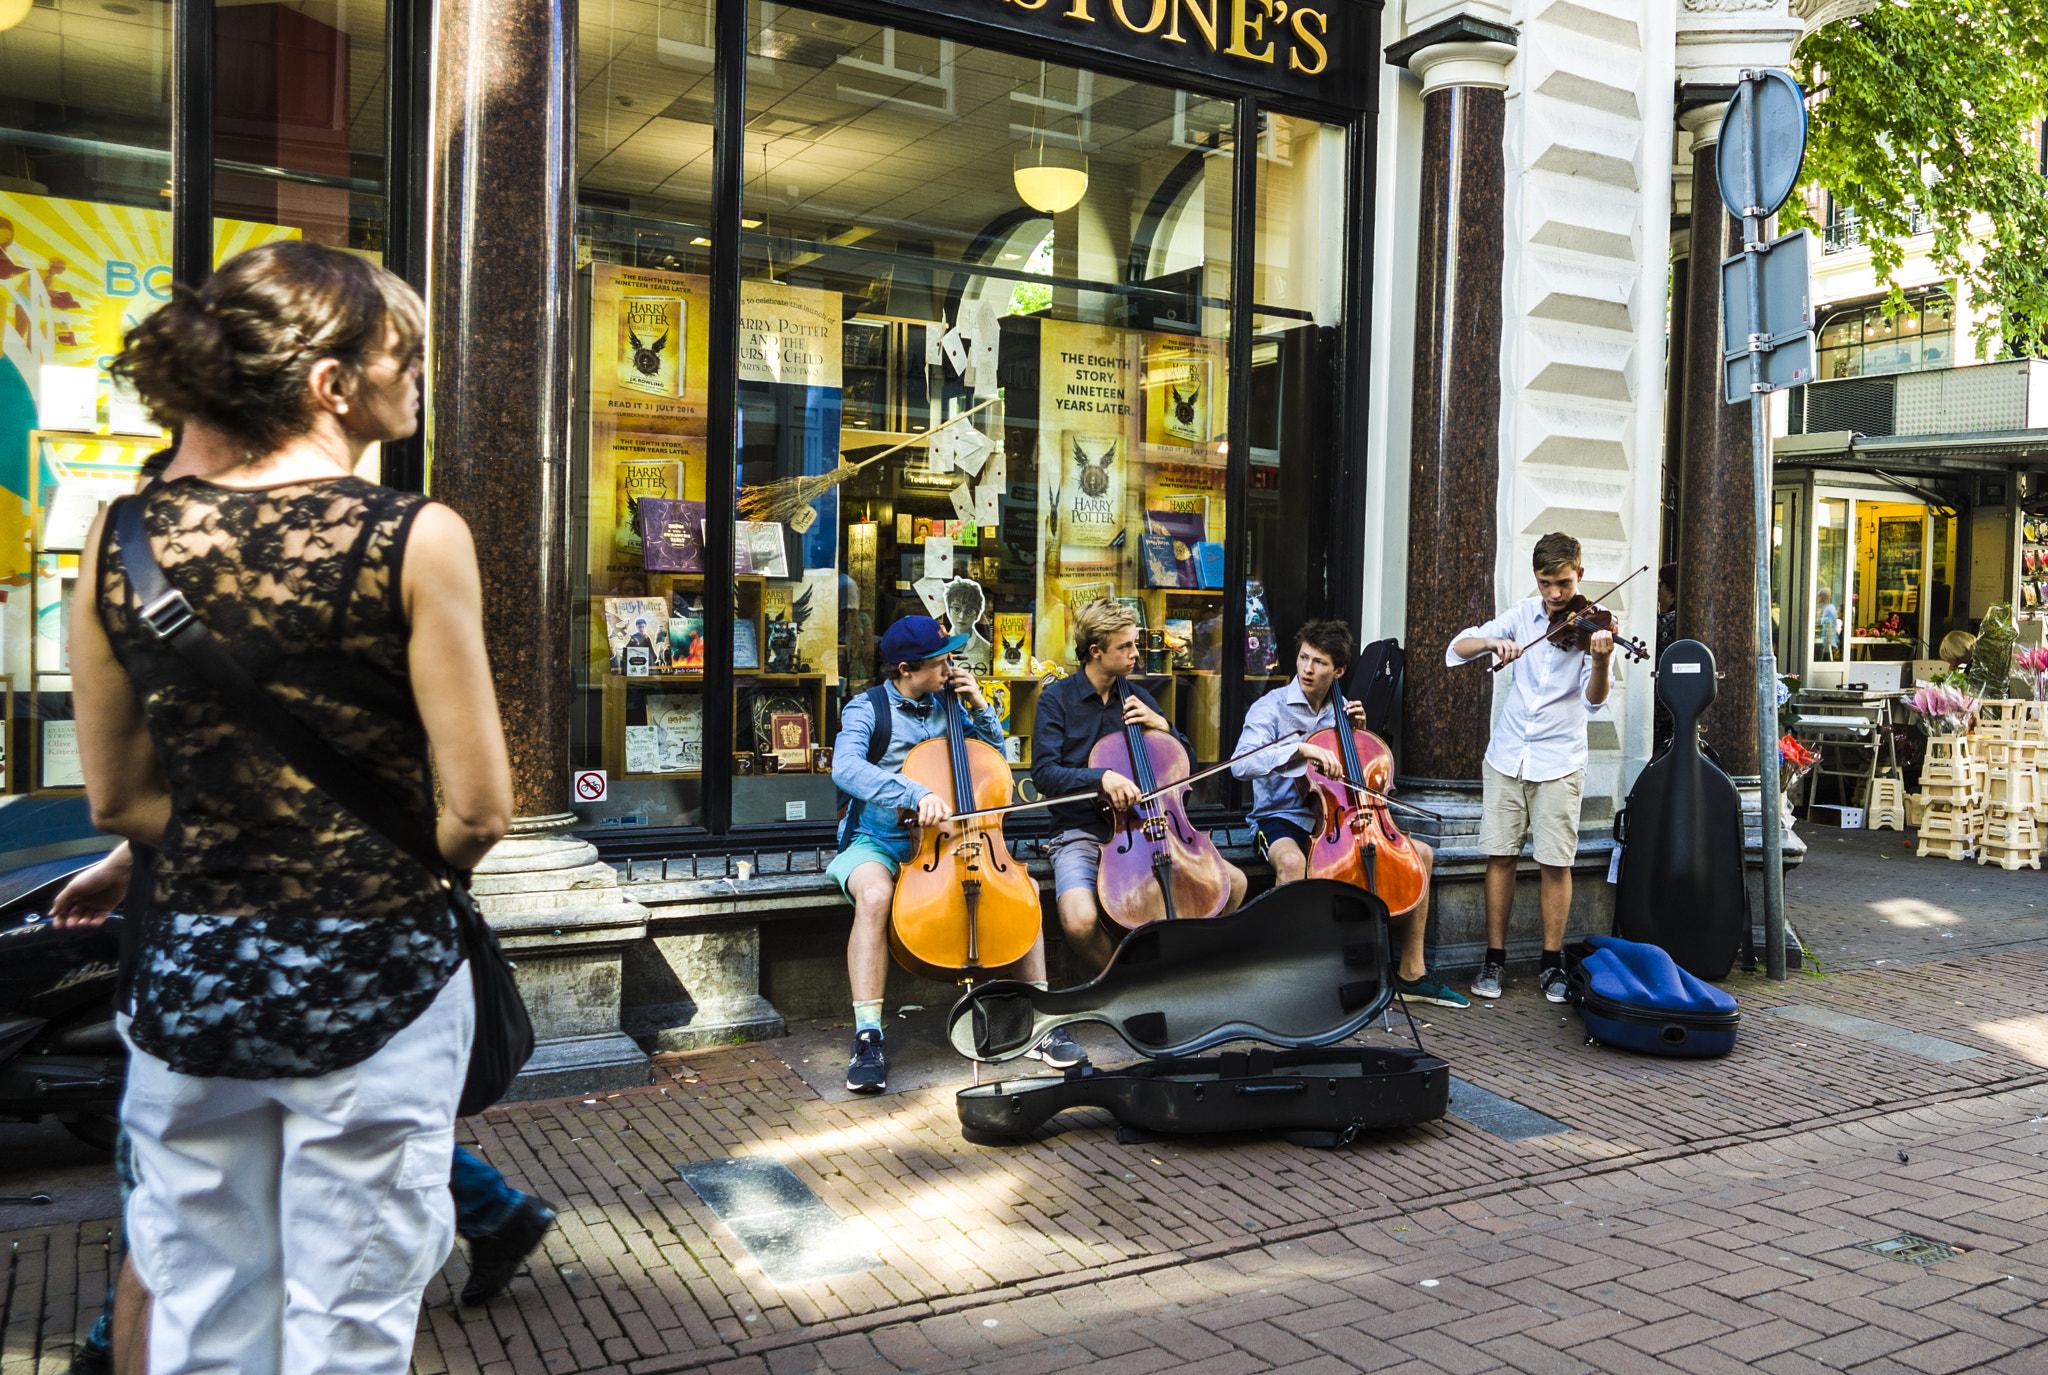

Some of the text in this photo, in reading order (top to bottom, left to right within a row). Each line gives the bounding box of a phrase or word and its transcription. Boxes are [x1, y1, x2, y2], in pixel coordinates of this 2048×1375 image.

[1003, 0, 1328, 74] ONE'S
[106, 260, 173, 301] BO
[615, 280, 648, 288] NINETEEN
[672, 286, 693, 294] LATER.
[664, 278, 686, 286] STORY.
[630, 302, 668, 314] HARRY
[756, 298, 789, 306] celebrate
[790, 301, 802, 309] the
[803, 305, 826, 320] launch
[627, 312, 670, 326] POTTER
[740, 318, 828, 338] ARRY POTTER
[750, 334, 806, 350] AND THE
[740, 348, 824, 364] URSED CHILD
[1060, 352, 1130, 370] THE EIGHTH
[739, 361, 760, 372] PARTS
[800, 368, 818, 376] TWO
[1076, 370, 1116, 384] STORY.
[1067, 384, 1124, 400] NINETEEN
[608, 400, 631, 408] READ
[656, 404, 675, 412] JULY
[677, 406, 694, 414] 2016
[1056, 398, 1134, 416] YEARS LATER.
[628, 466, 666, 478] HARRY
[625, 476, 667, 488] POTTER
[928, 476, 952, 485] Fiction
[1074, 497, 1114, 512] HARRY
[1170, 500, 1196, 510] HARRY
[1072, 510, 1116, 524] POTTER
[766, 590, 786, 598] ARRY
[1072, 589, 1098, 600] HARRY
[1002, 616, 1024, 625] HARRY
[1001, 624, 1026, 632] POTTER
